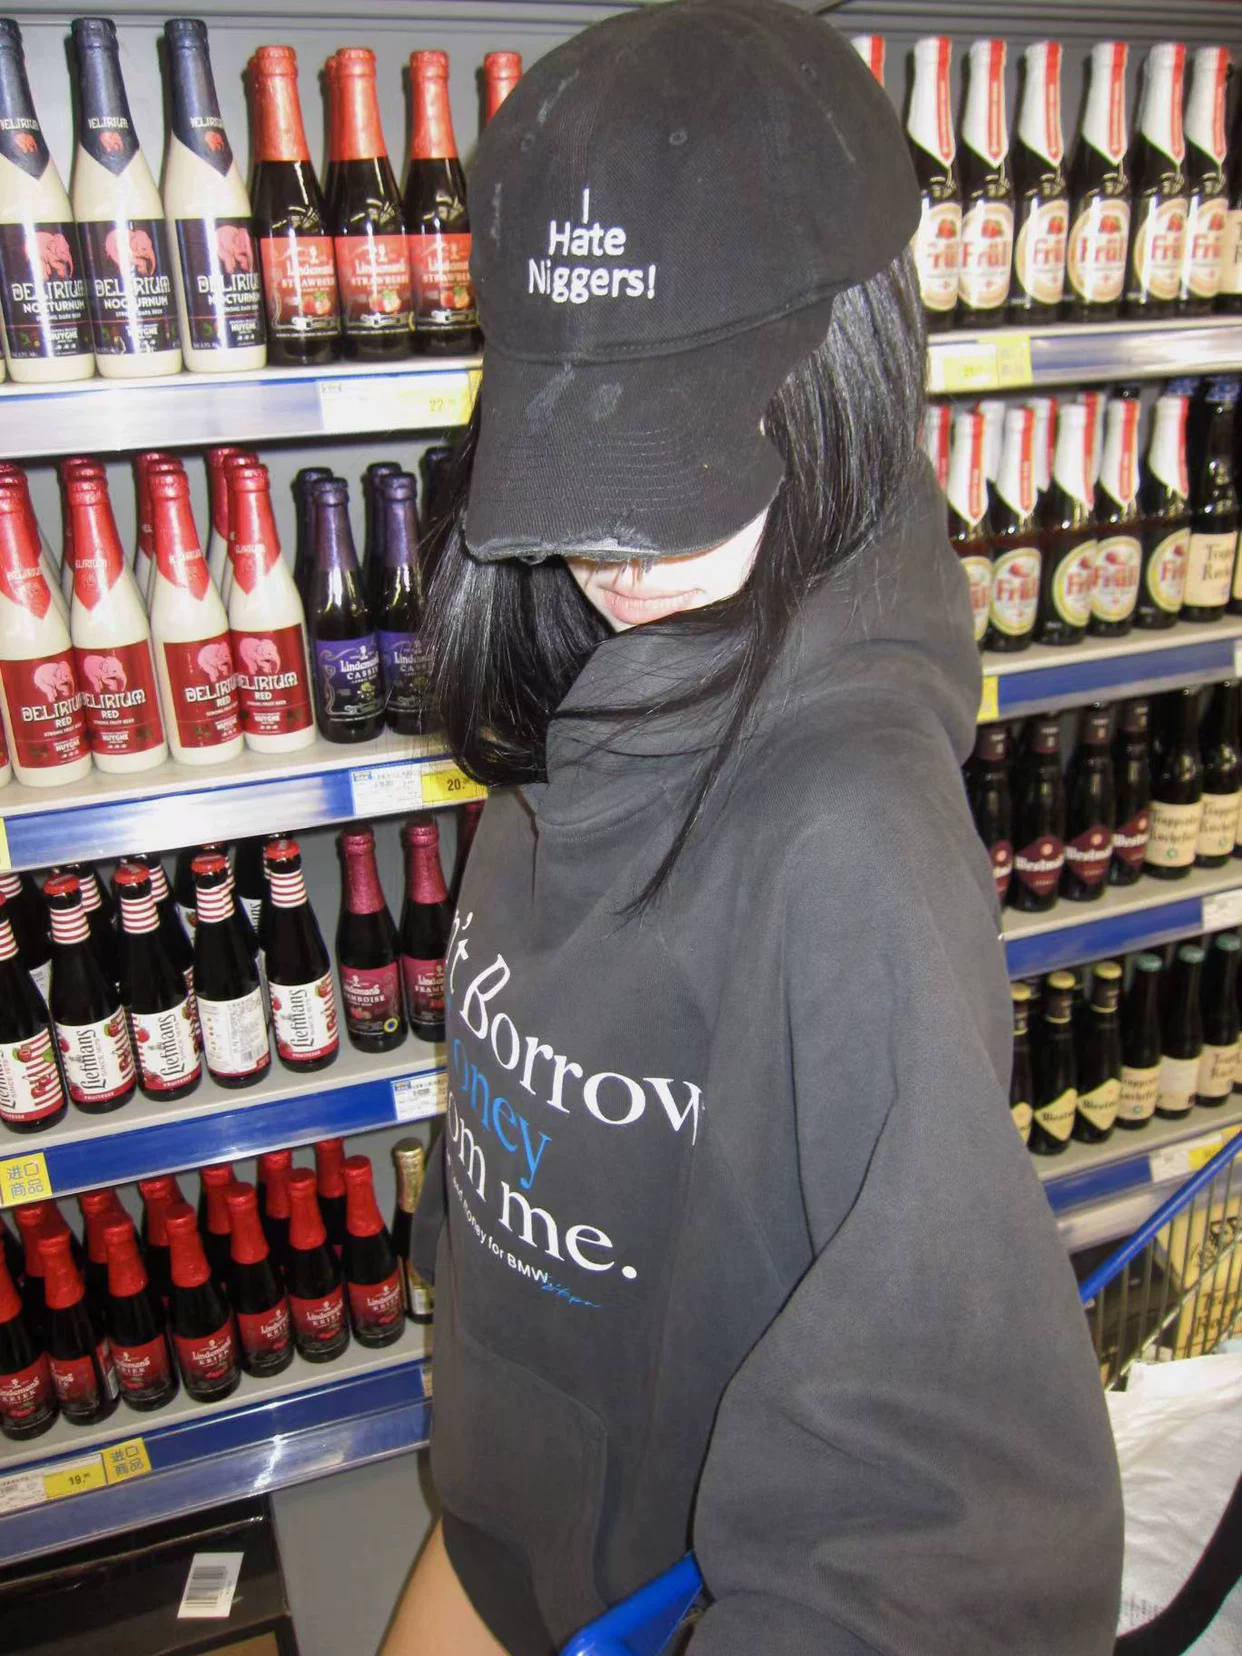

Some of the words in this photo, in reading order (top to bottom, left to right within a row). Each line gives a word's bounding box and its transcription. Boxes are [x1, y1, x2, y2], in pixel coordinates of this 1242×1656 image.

[582, 188, 590, 224] I
[548, 220, 627, 257] Hate
[12, 279, 86, 302] DEIRIUM
[95, 276, 171, 297] DELRIUM
[528, 258, 656, 305] Niggers!
[23, 300, 85, 314] NOTURNUM
[104, 296, 169, 310] NOCURNUM
[185, 675, 240, 702] DELIRIU
[240, 672, 298, 690] ELIRIUM
[22, 693, 84, 722] DELIRIU
[83, 689, 146, 709] ELIRIUM
[55, 716, 73, 728] RED
[101, 710, 119, 719] RED
[77, 1029, 107, 1090] Liefmans
[453, 1038, 552, 1189] oney
[498, 1180, 637, 1281] me.
[488, 1235, 504, 1260] for
